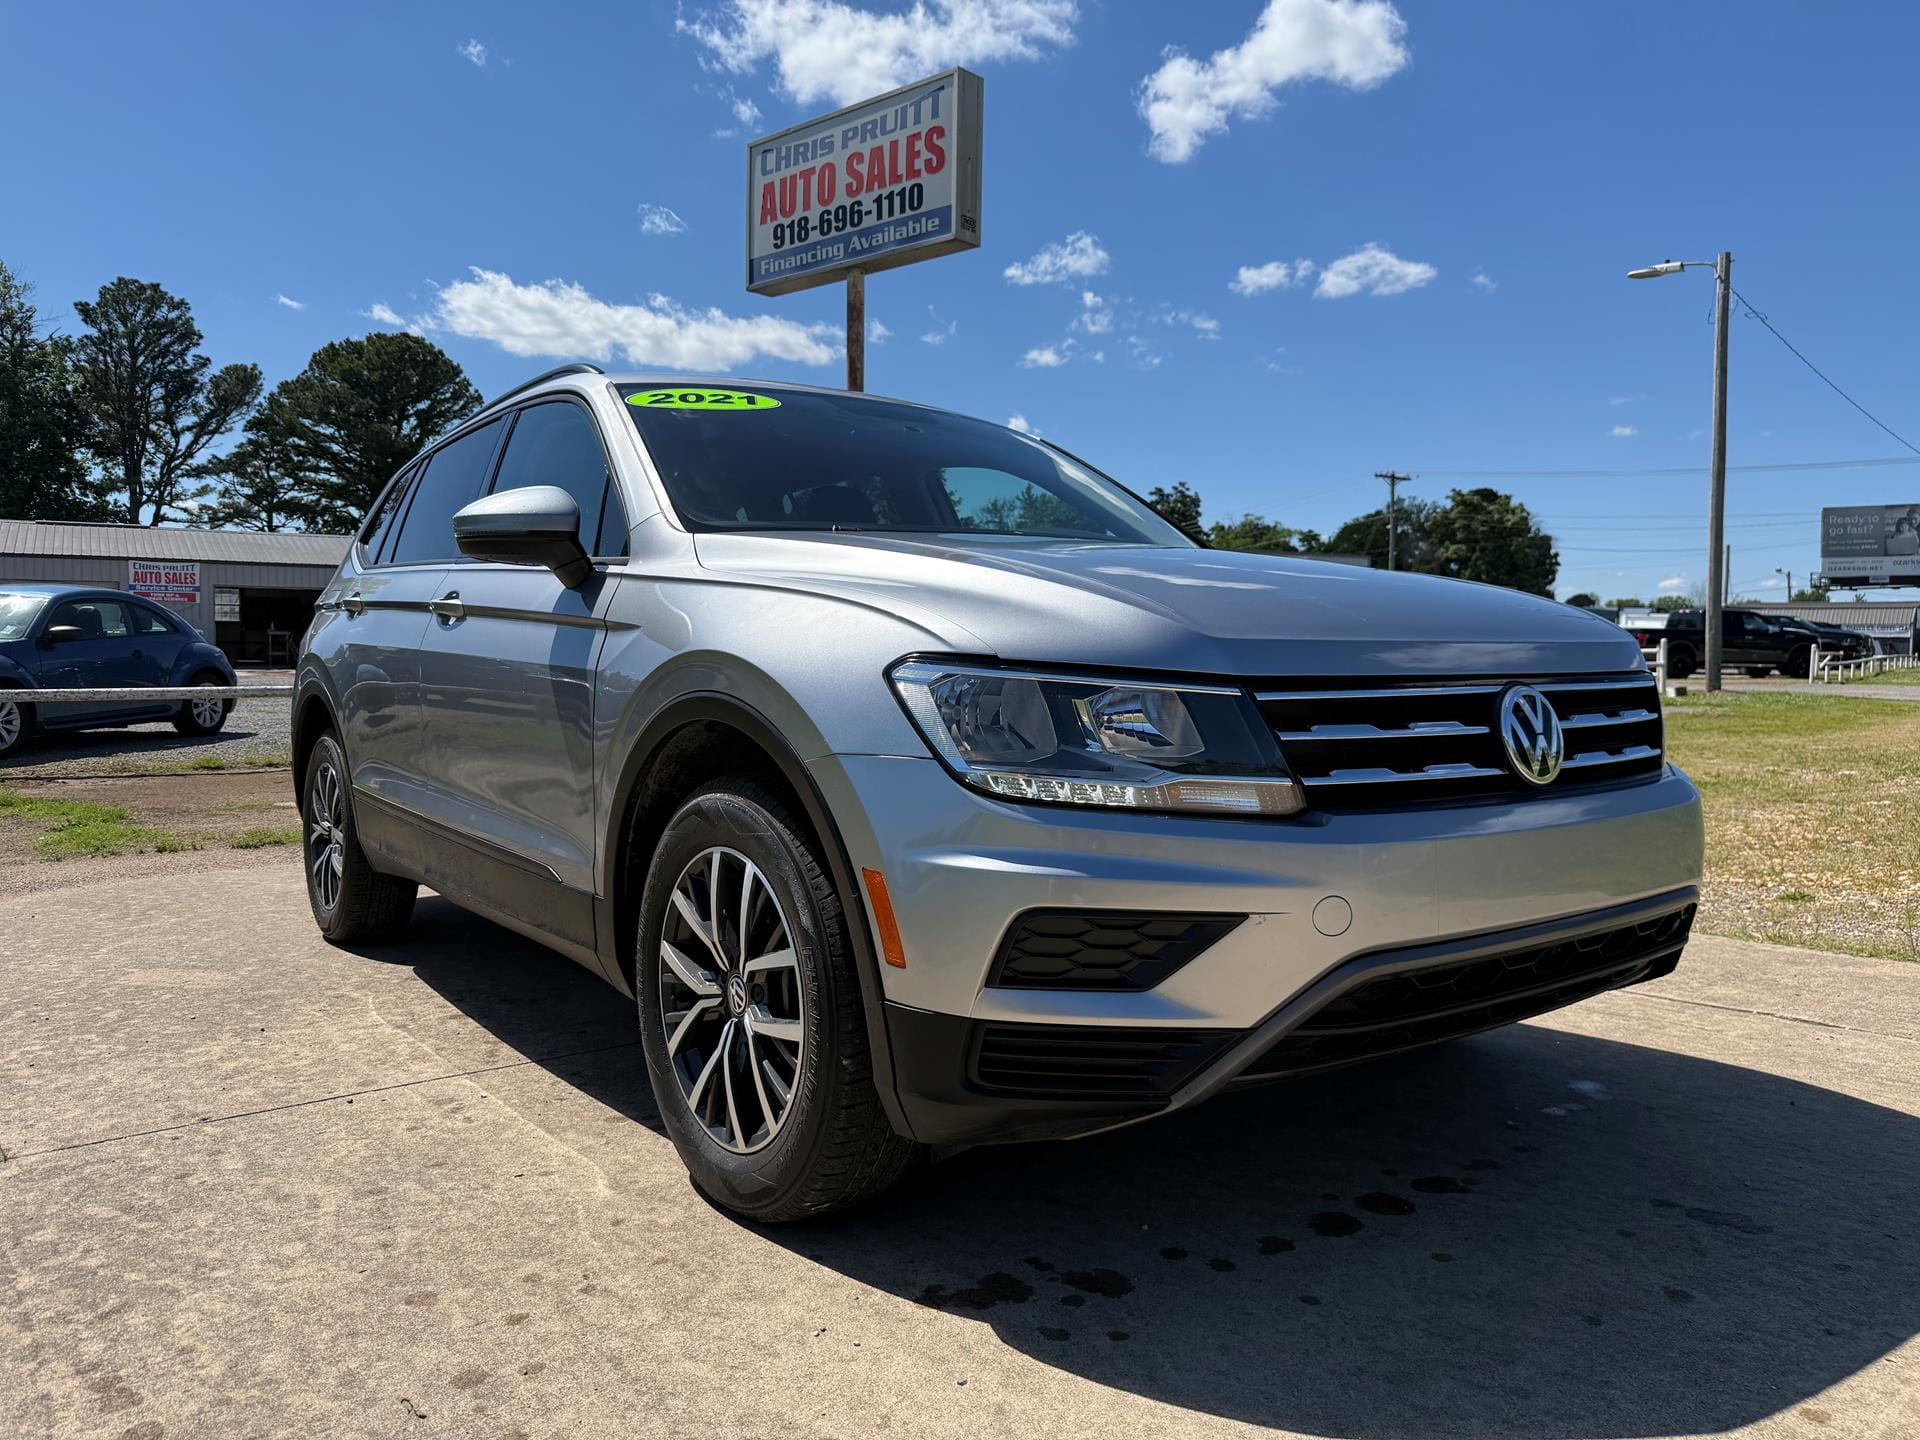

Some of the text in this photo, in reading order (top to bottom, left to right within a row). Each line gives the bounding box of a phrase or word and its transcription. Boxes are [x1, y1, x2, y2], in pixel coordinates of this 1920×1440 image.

[760, 85, 945, 177] CHRIS PRUITT
[760, 125, 946, 226] AUTO SALES
[772, 183, 924, 250] 918-696-1110
[760, 241, 844, 275] Financing
[848, 215, 940, 253] Available
[647, 393, 758, 406] 2021
[1829, 515, 1880, 525] Ready to
[1828, 527, 1844, 536] go
[133, 562, 196, 571] CHRIS PRUITT
[133, 571, 196, 585] AUTO SALES
